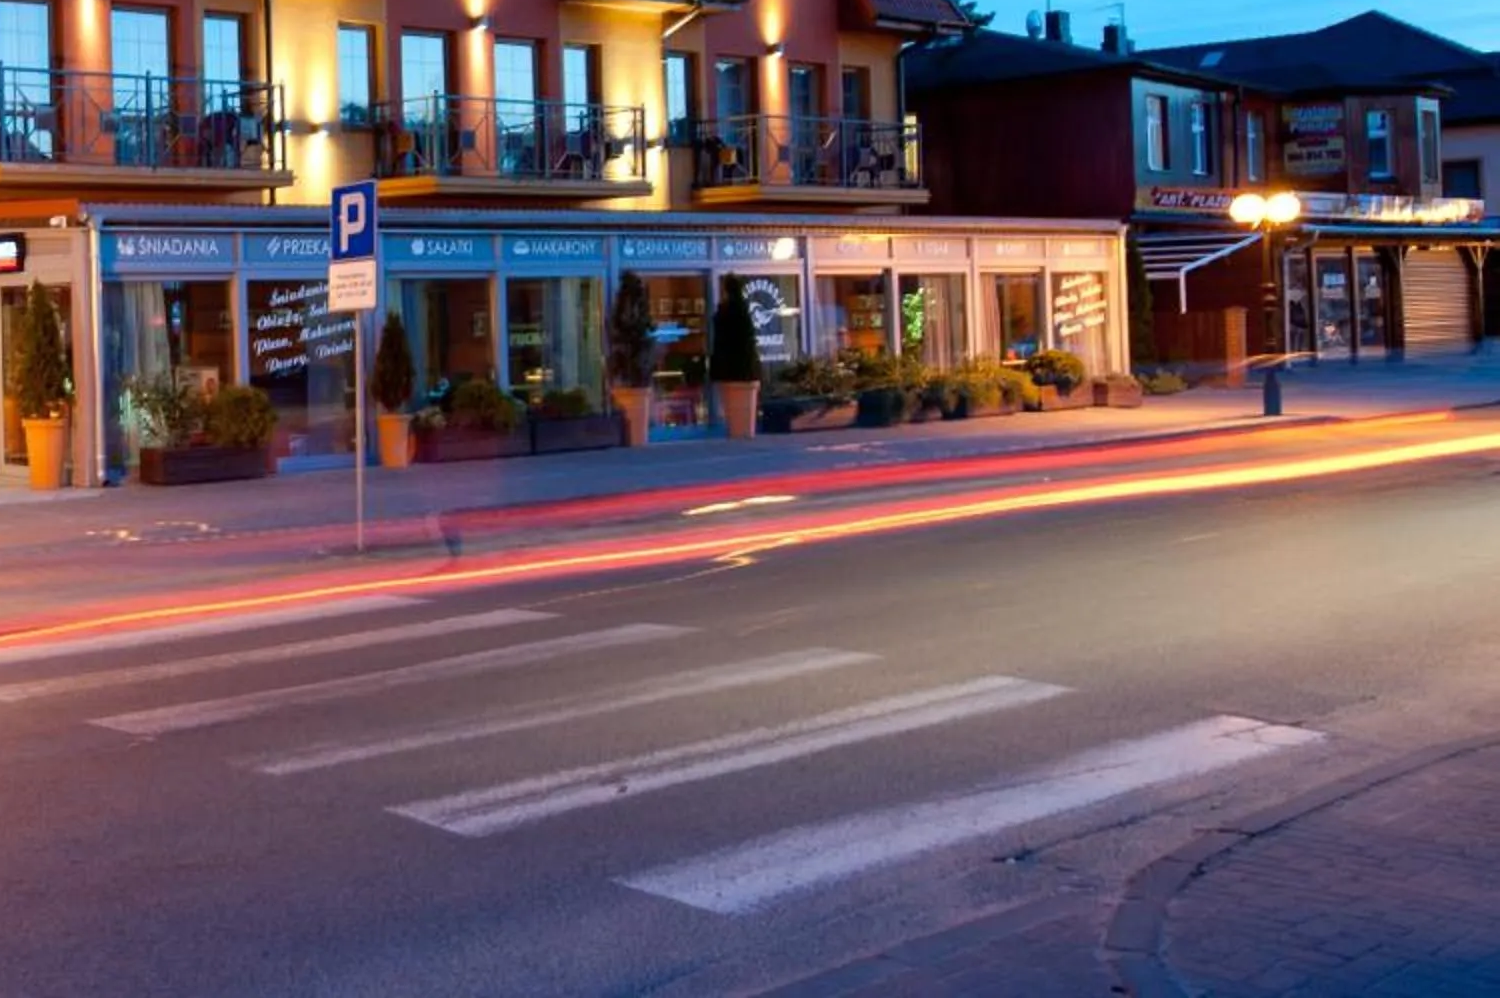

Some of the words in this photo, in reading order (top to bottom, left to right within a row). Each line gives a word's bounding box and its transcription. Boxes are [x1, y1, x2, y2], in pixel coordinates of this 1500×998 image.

[340, 192, 366, 252] P
[138, 236, 219, 256] ŚNIADANIA
[531, 239, 596, 255] MAKARONY
[269, 281, 329, 307] Śniadani
